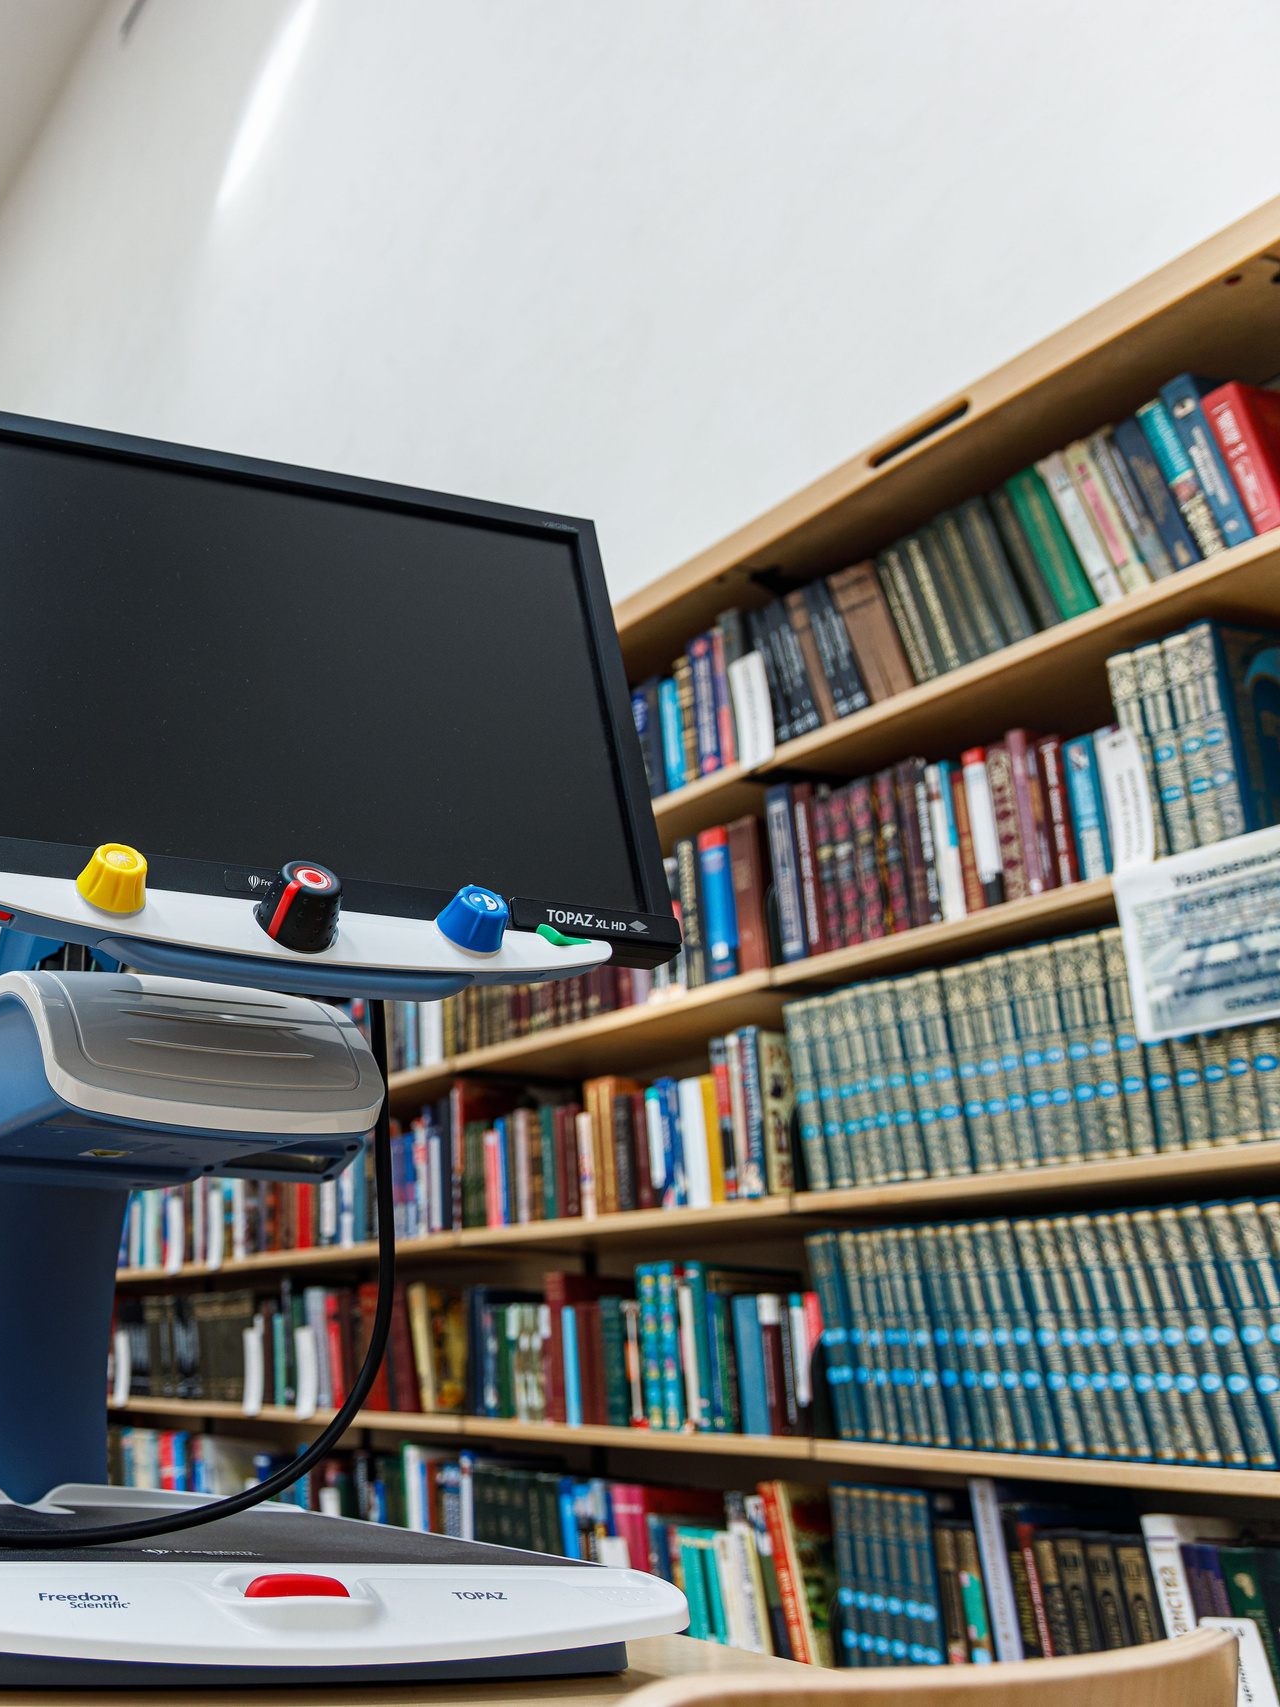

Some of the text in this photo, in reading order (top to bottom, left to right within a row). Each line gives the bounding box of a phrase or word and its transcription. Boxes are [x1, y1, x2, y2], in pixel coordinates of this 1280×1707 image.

[546, 909, 627, 931] TOPAZ XL HD
[38, 1591, 119, 1601] Freedom
[451, 1591, 508, 1600] TOPAZ
[69, 1601, 130, 1609] Scientific
